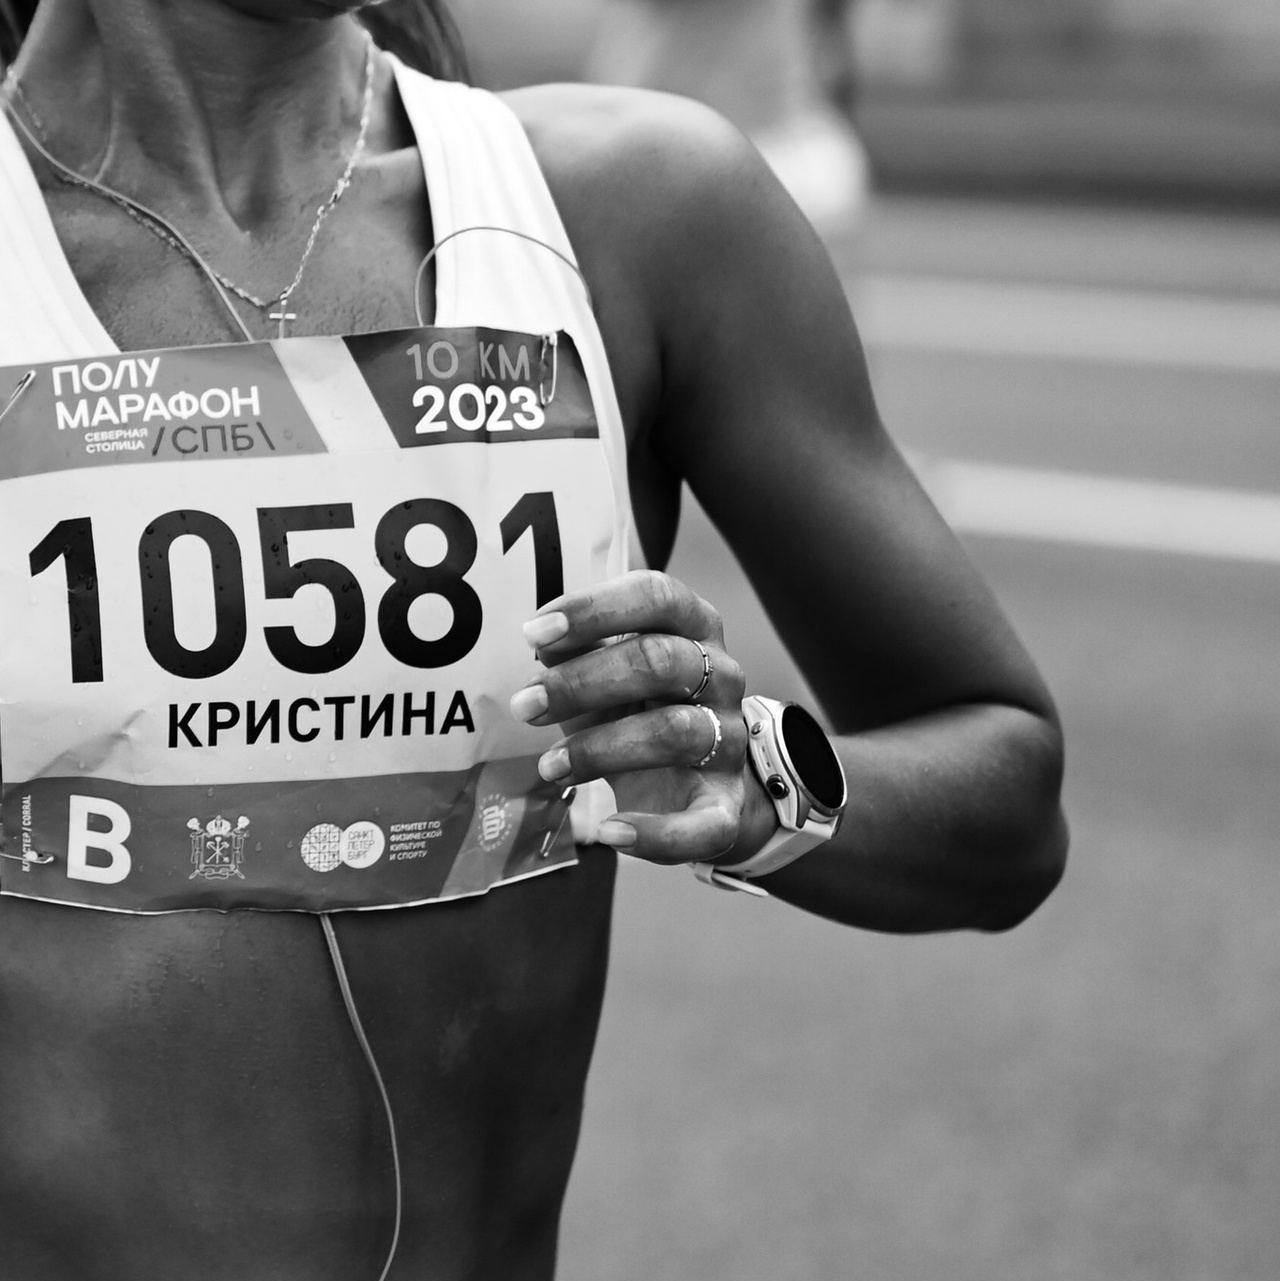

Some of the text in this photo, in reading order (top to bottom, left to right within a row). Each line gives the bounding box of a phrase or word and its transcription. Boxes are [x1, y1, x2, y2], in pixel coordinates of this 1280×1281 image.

[52, 357, 160, 396] ПОЛУ
[406, 340, 459, 380] 10
[55, 385, 261, 430] МАРАФОН
[412, 383, 545, 434] 2023
[85, 427, 148, 443] СЕВЕРНАЯ
[86, 439, 145, 454] СТОЛИЦА
[29, 491, 565, 684] 10581
[168, 690, 476, 748] КРИСТИНА
[21, 794, 32, 826] CORRAL
[390, 821, 441, 832] КОМИТЕТ ПО
[397, 851, 427, 860] СПОРТУ
